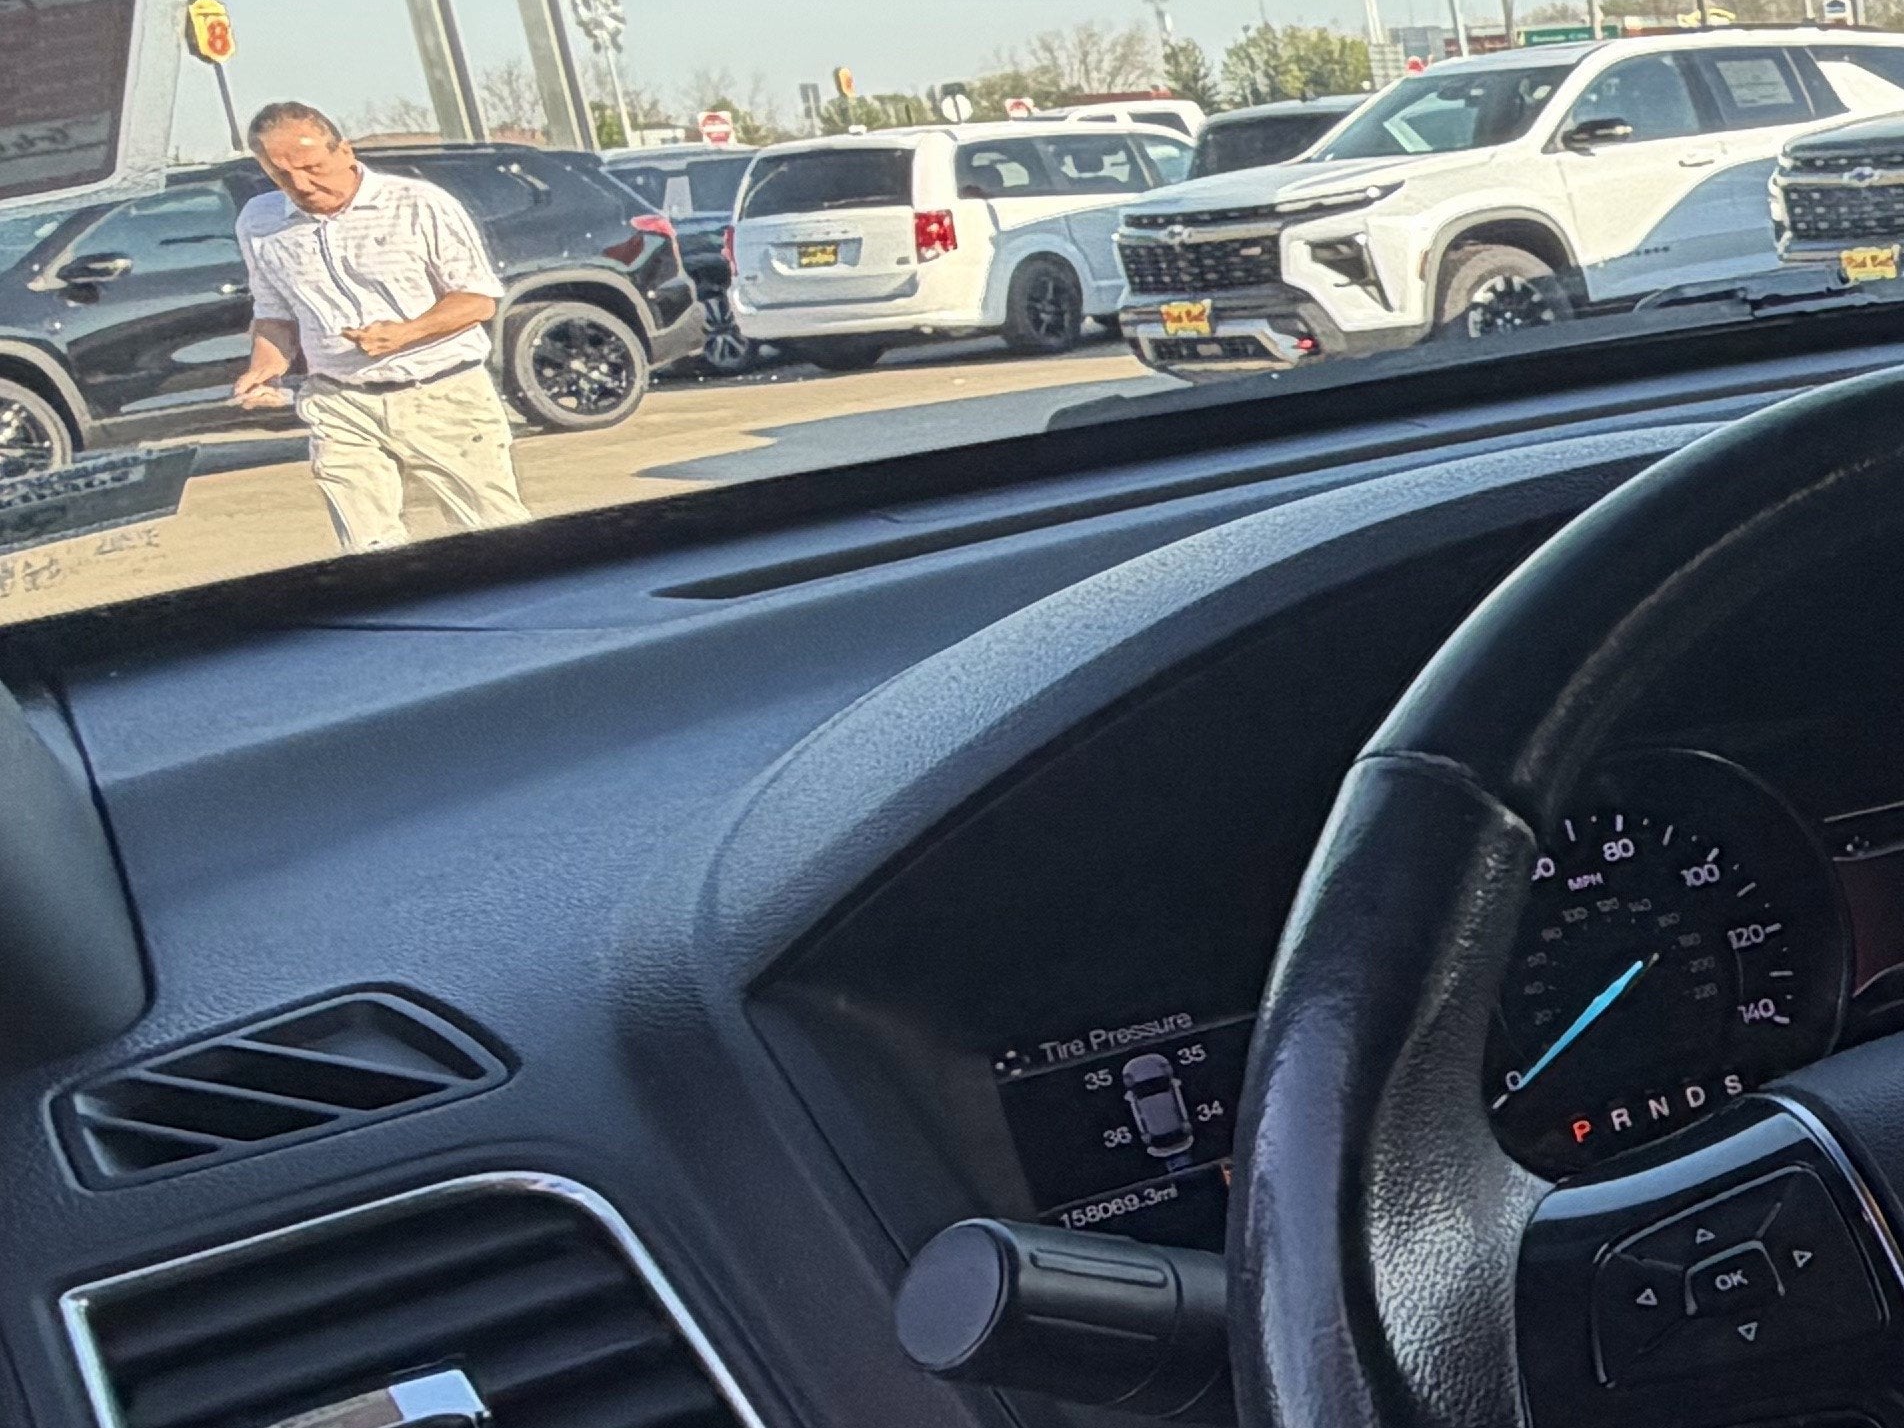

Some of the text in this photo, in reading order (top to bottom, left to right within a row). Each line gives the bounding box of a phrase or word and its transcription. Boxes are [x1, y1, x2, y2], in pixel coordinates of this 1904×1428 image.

[1602, 837, 1636, 863] 80
[1530, 857, 1557, 882] 0
[1566, 871, 1604, 892] MPH
[1680, 862, 1721, 888] 100
[1727, 923, 1766, 951] 120
[1736, 997, 1776, 1025] 140
[1038, 1012, 1194, 1063] Tire Pressure
[1084, 1043, 1207, 1091] 35 35
[1572, 1073, 1744, 1144] P R N D S
[1102, 1099, 1224, 1149] 36 34
[1714, 1268, 1749, 1292] OK
